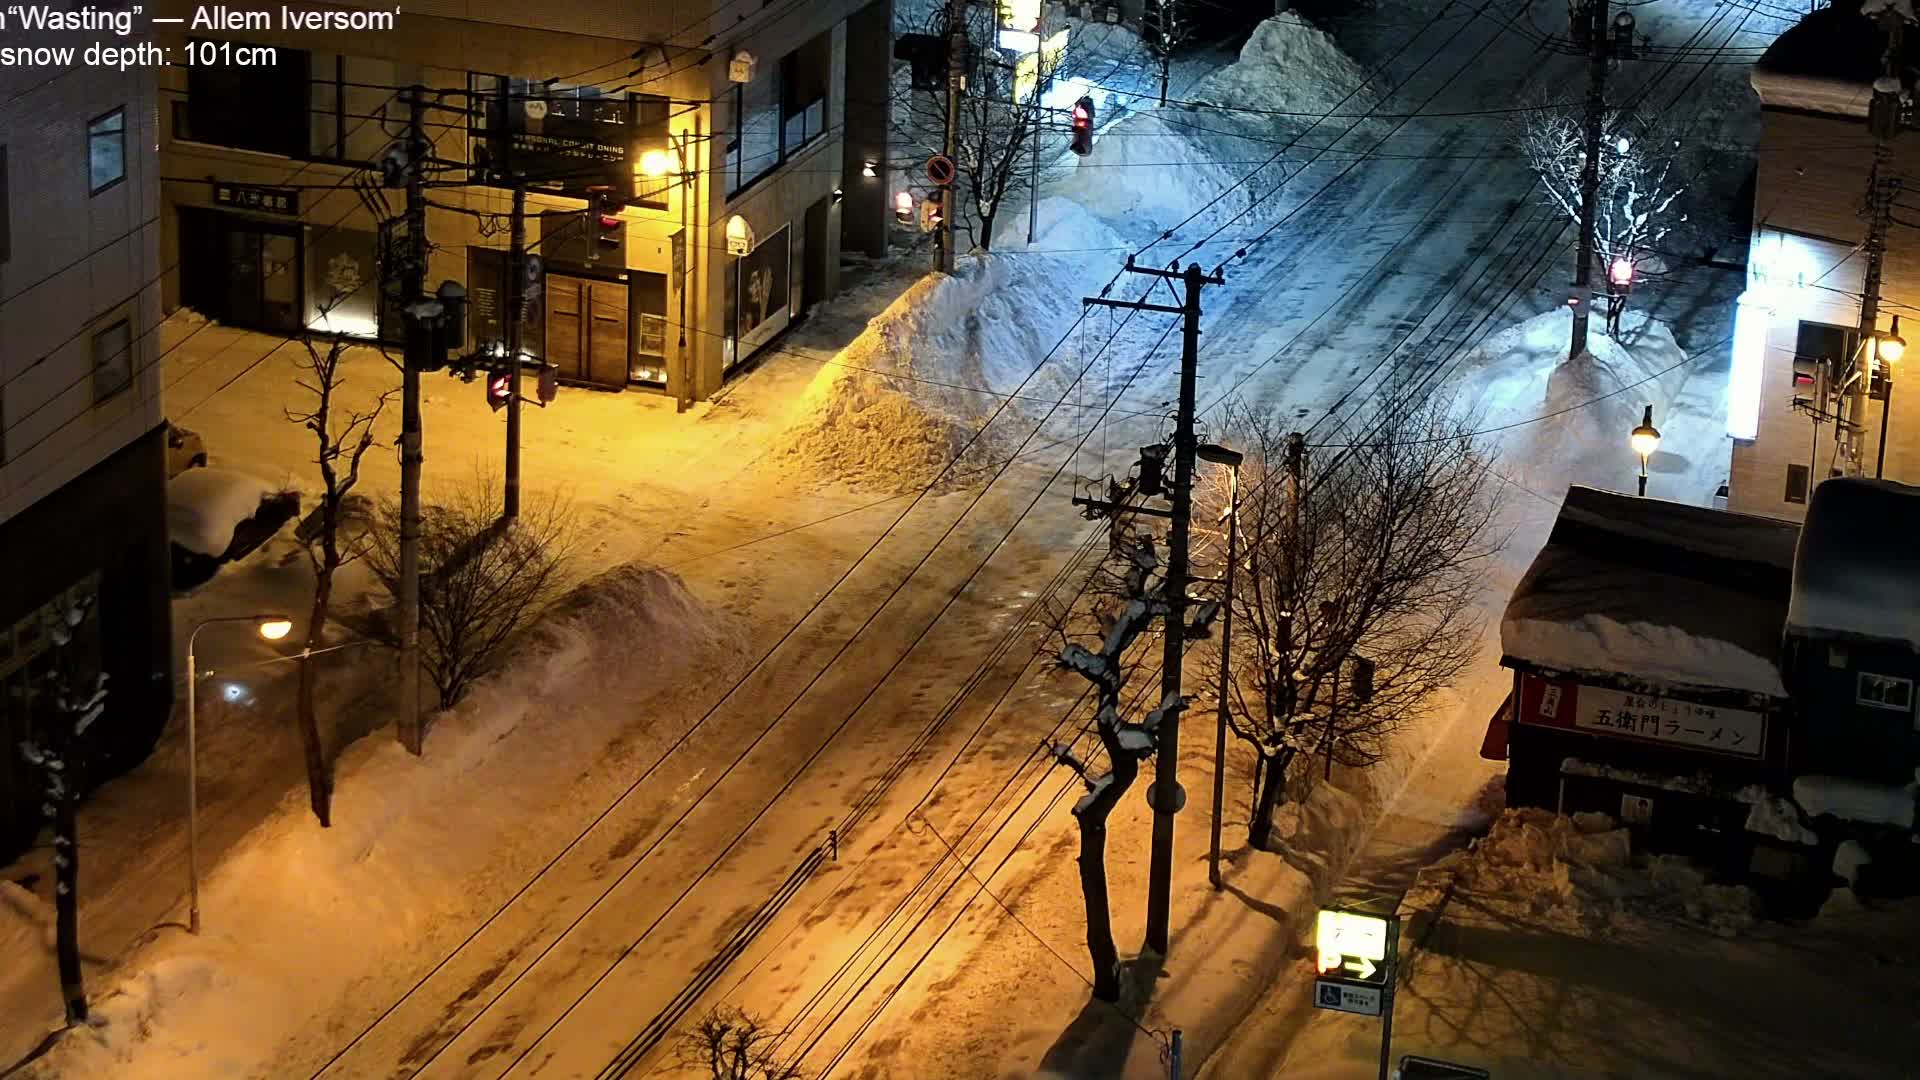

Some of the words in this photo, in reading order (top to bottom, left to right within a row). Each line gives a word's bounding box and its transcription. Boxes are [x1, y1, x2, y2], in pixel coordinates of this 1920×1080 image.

[1593, 709, 1745, 745] 五衛門ラーメン
